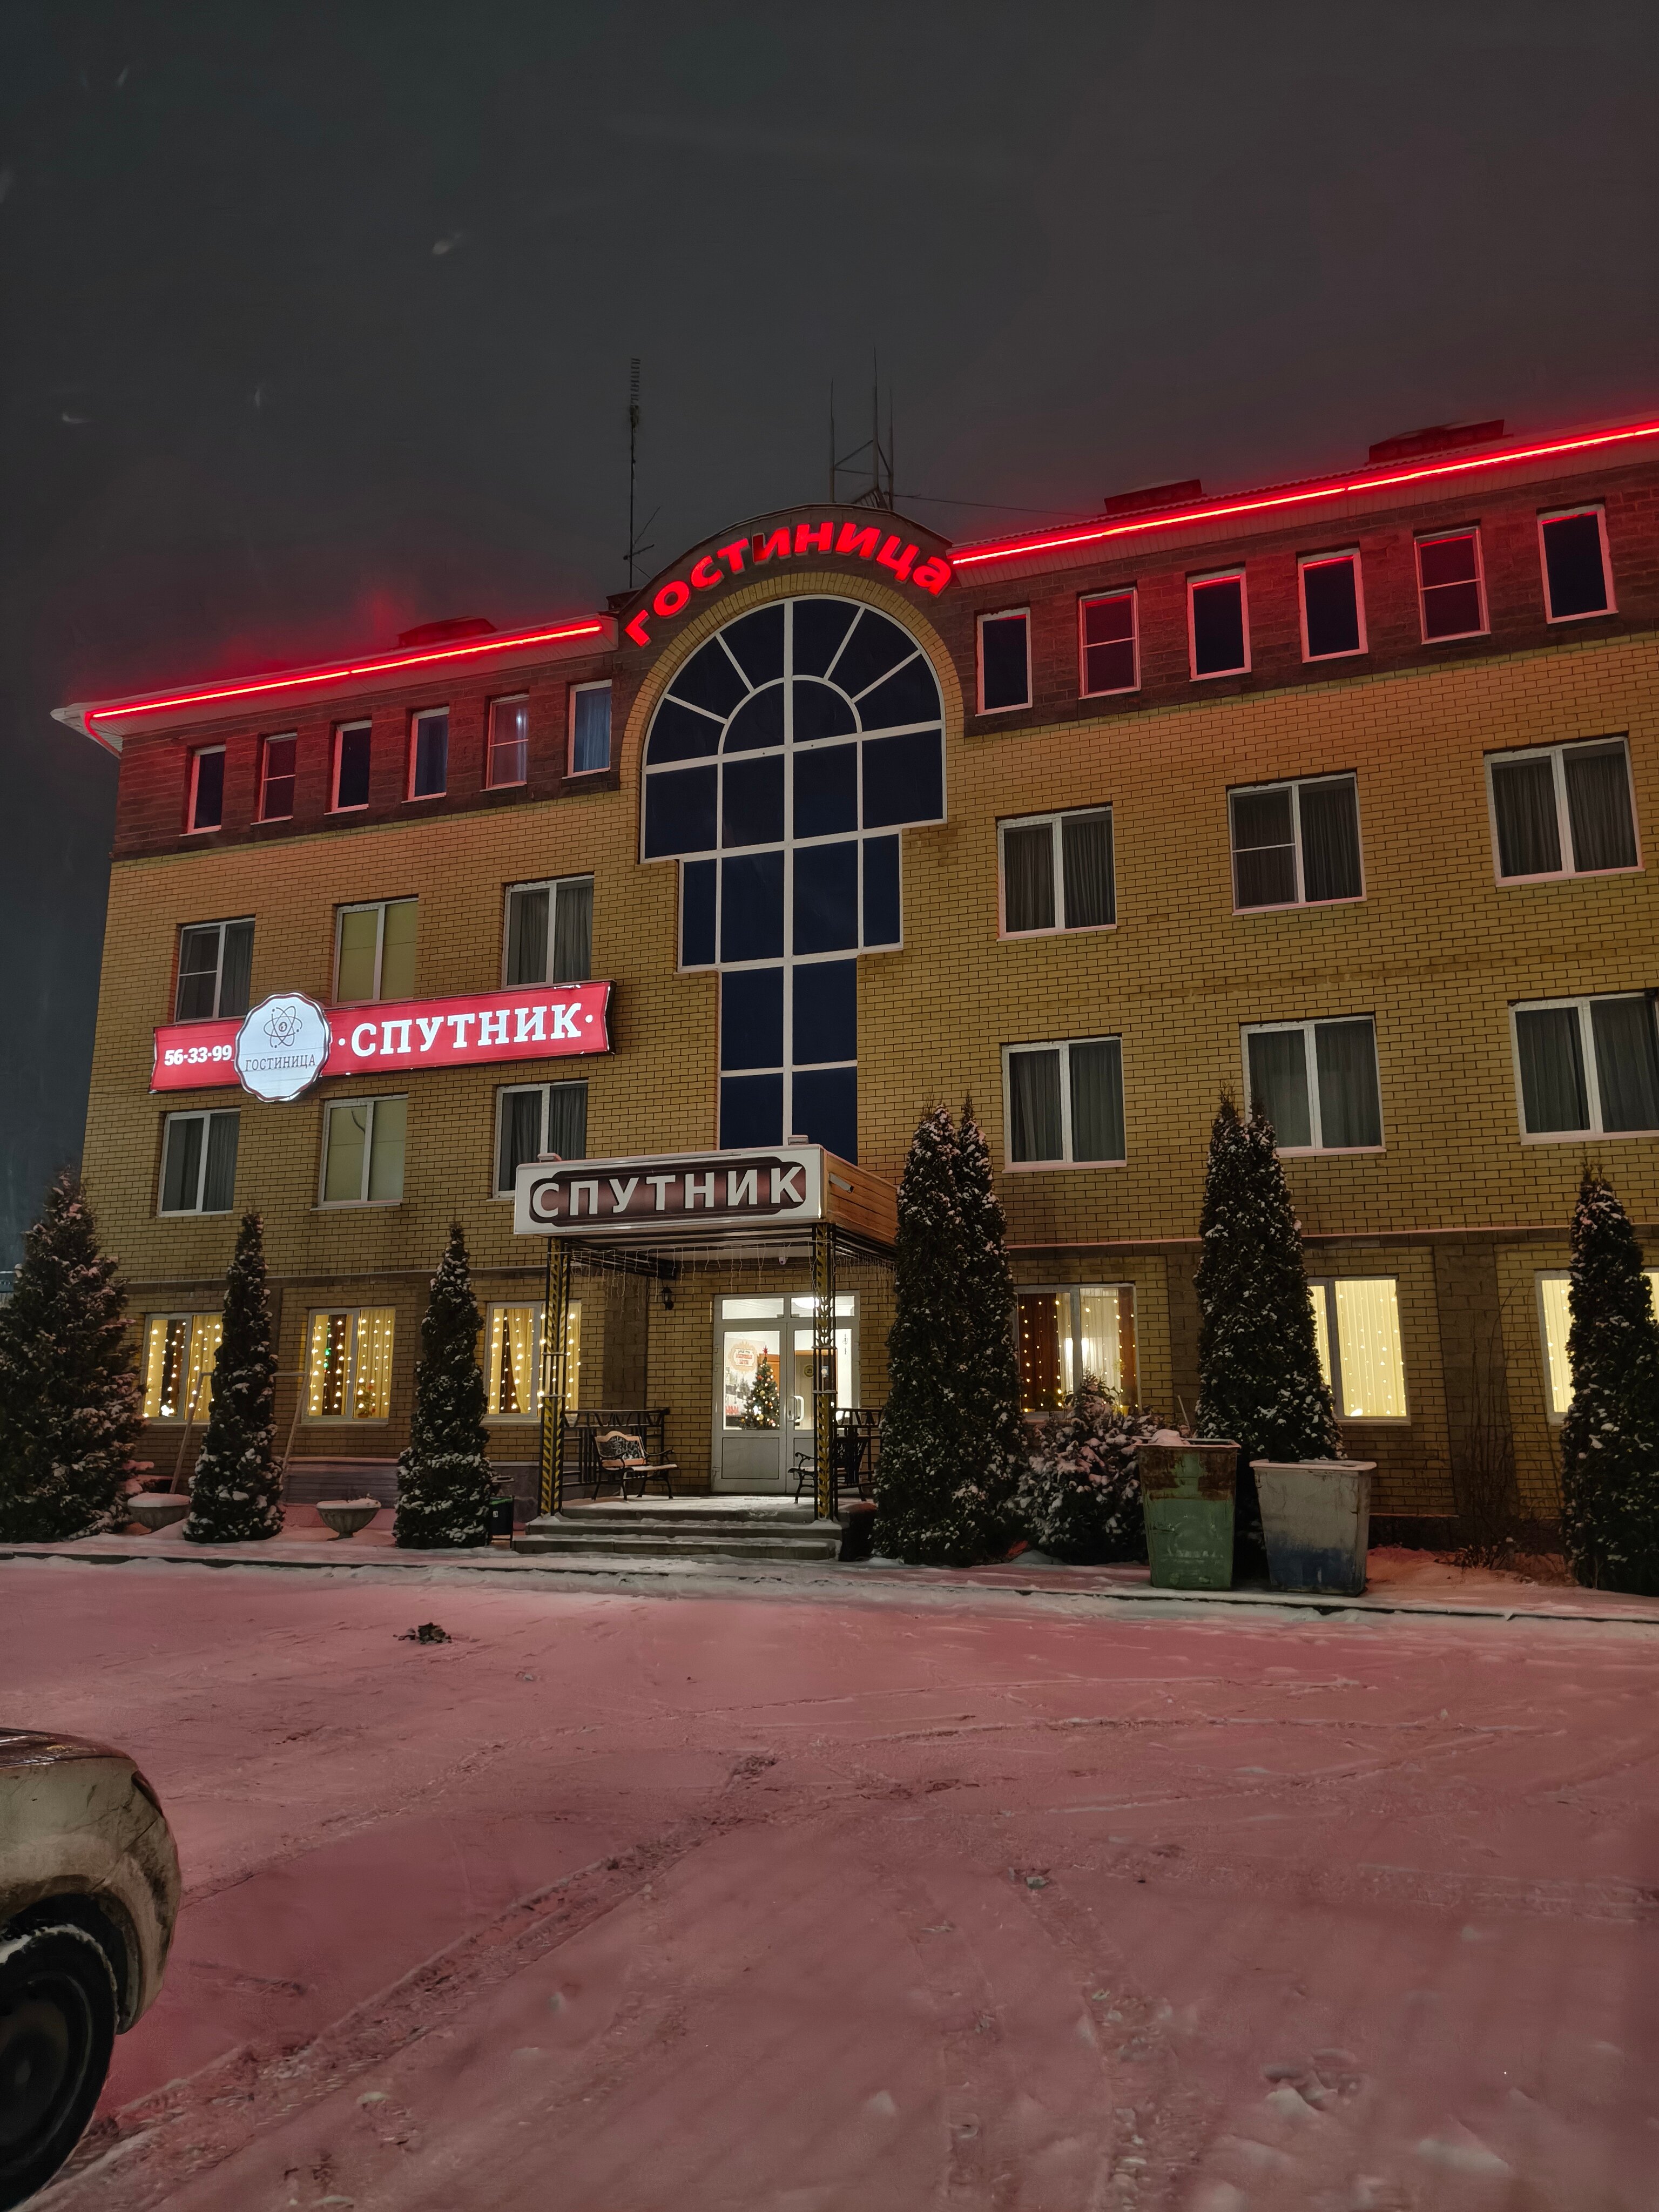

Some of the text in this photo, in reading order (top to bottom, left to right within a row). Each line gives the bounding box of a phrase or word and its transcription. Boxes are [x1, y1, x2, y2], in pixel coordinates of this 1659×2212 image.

[351, 1003, 582, 1057] СПУТНИК
[164, 1045, 232, 1066] 56-33-99
[245, 1054, 315, 1071] ГОСТИНИЦА
[532, 1166, 804, 1218] СПУТНИК
